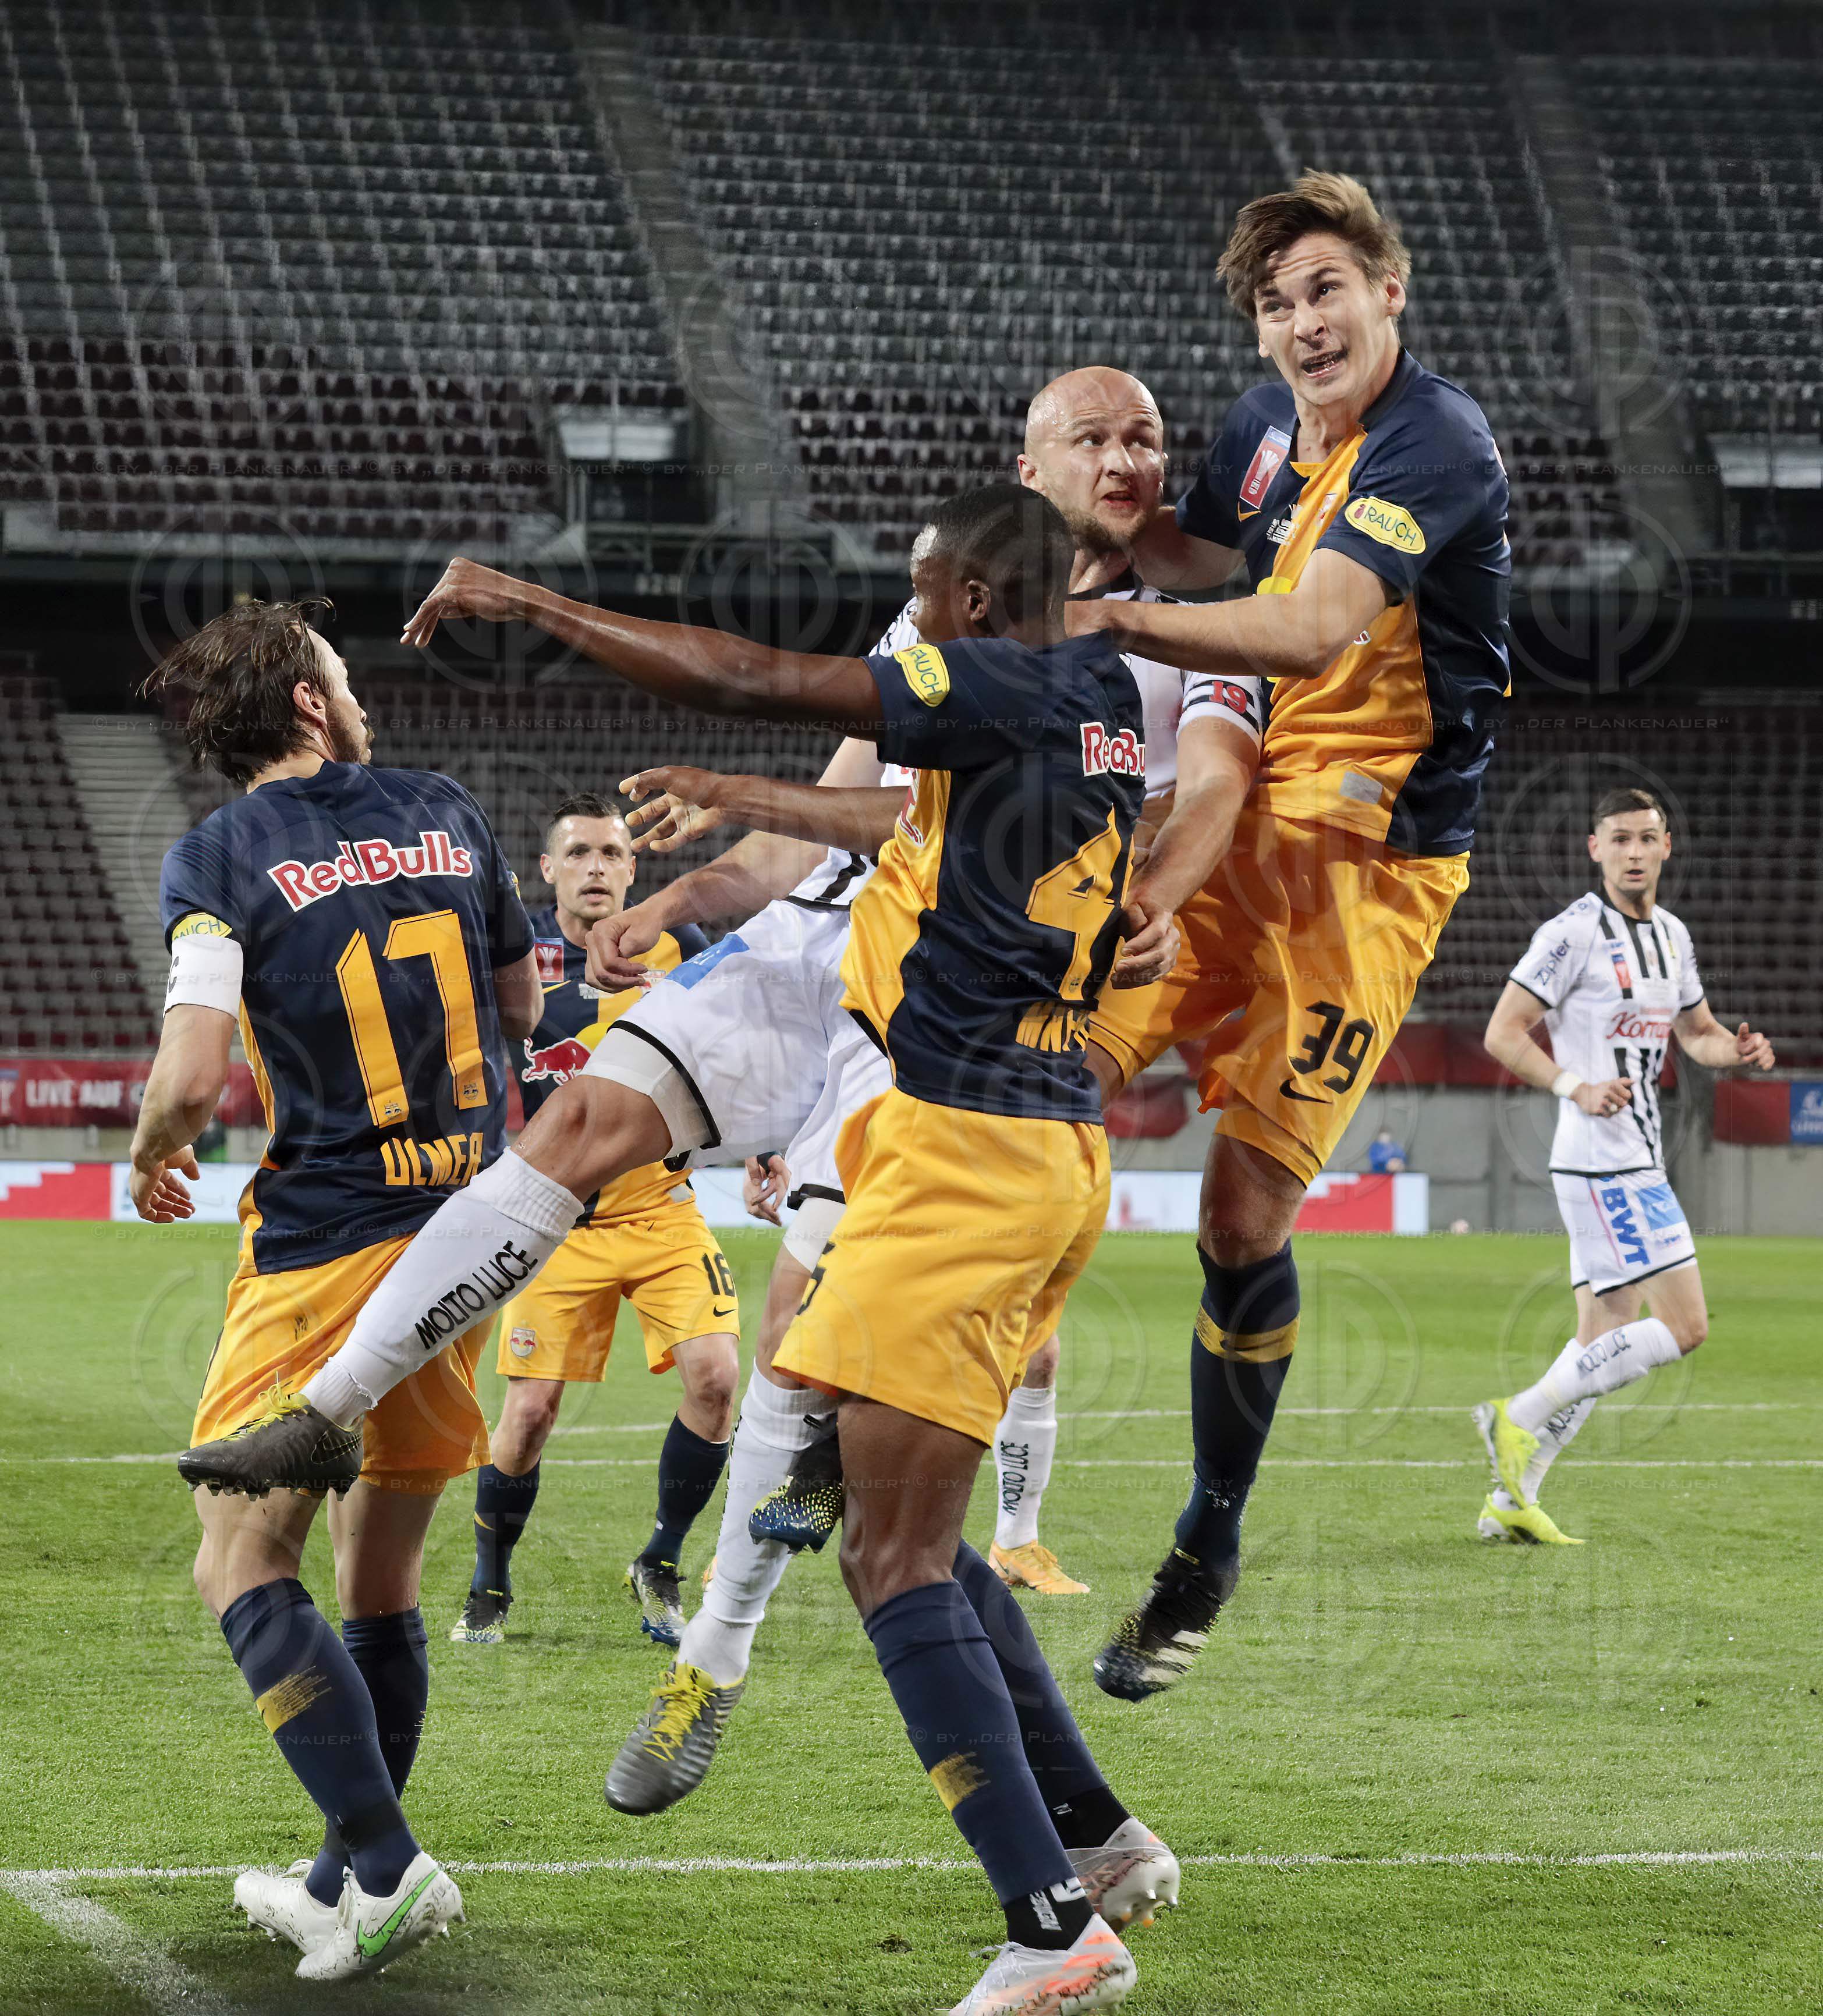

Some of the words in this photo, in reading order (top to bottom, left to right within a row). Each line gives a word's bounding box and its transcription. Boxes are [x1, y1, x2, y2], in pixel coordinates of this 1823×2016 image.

[1364, 506, 1417, 546] RAUCH
[910, 649, 943, 696] AUCH
[1210, 680, 1247, 714] 19
[1026, 803, 1135, 1000] 4
[335, 909, 488, 1129] 17
[1288, 1000, 1374, 1095] 39
[26, 1080, 74, 1108] LIVE
[79, 1080, 123, 1108] AUF
[380, 1132, 484, 1186] ULMER
[1601, 1187, 1650, 1265] BWT
[414, 1283, 485, 1350] MOLTO
[472, 1240, 538, 1300] LUCE
[701, 1252, 736, 1297] 16
[1002, 1471, 1026, 1516] MOLTO
